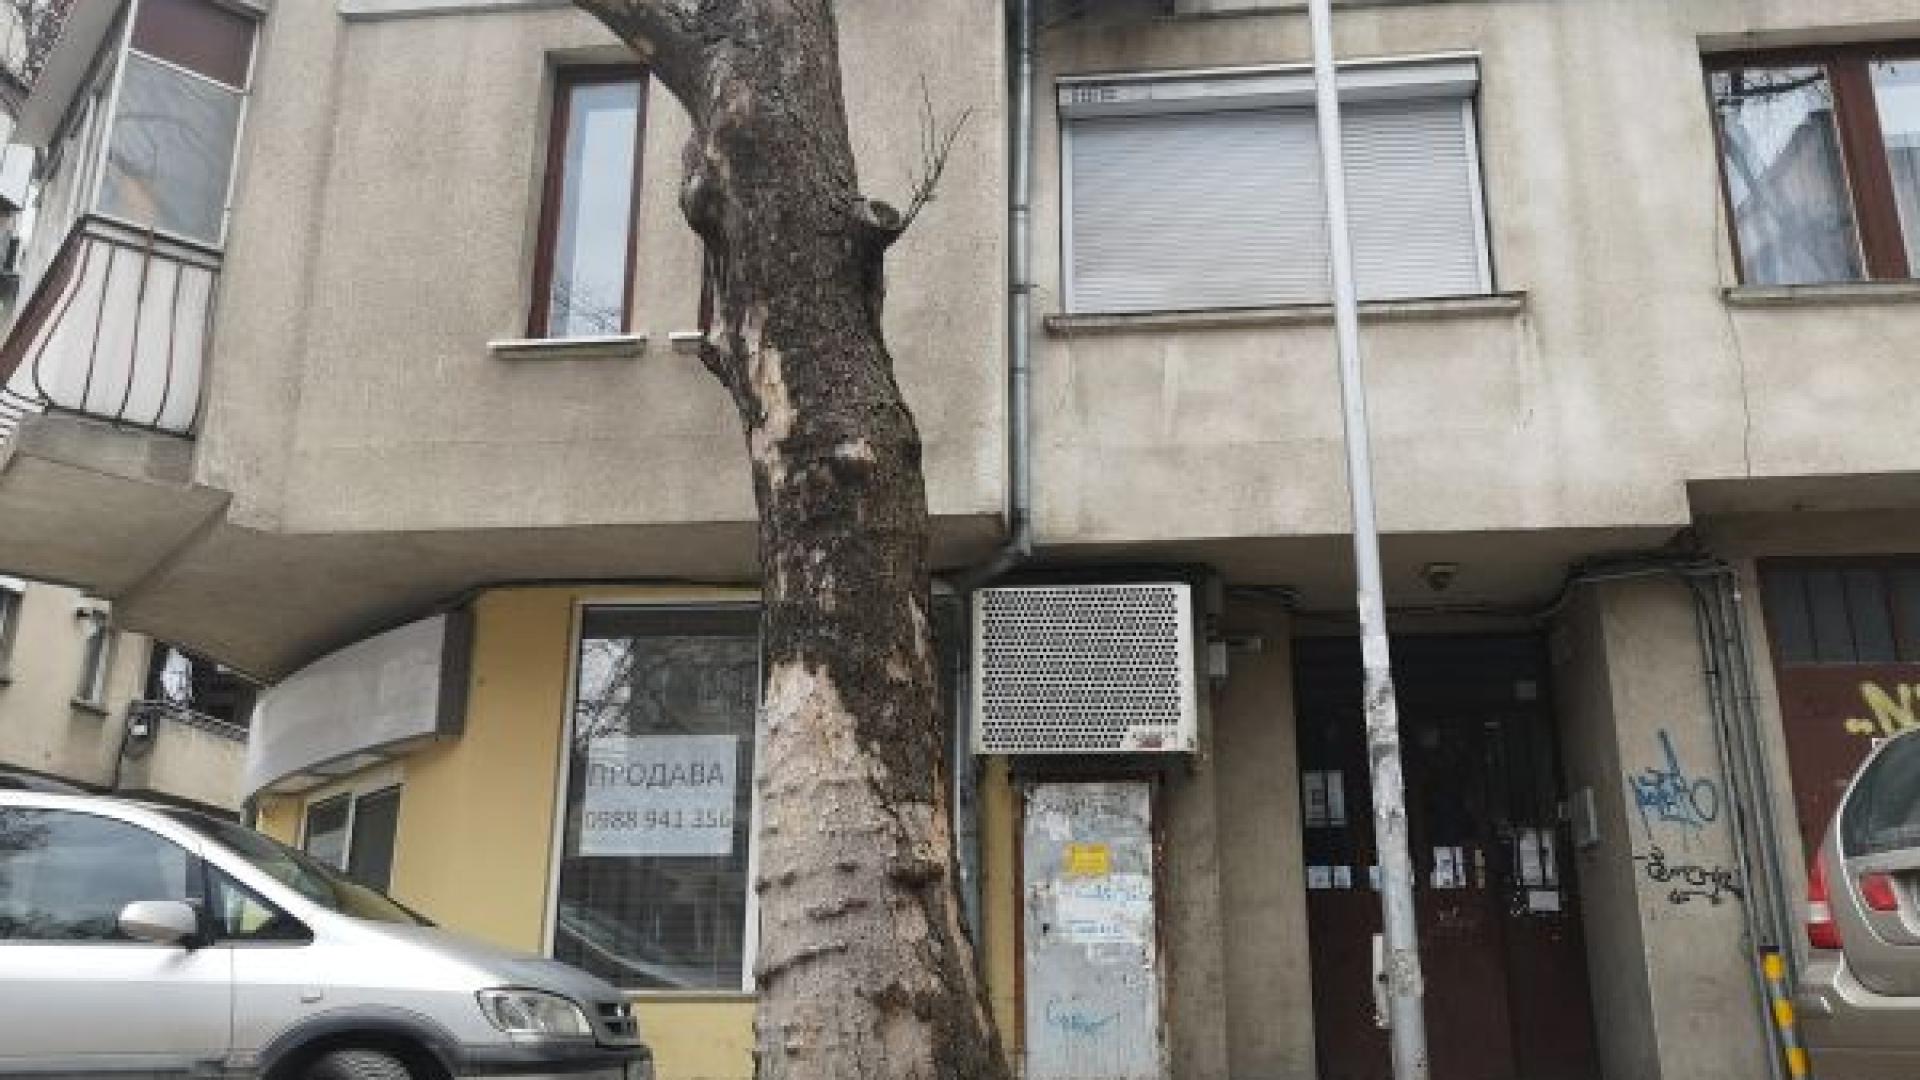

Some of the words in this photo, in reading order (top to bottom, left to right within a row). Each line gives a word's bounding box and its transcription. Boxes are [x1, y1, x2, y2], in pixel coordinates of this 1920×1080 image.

[587, 761, 725, 788] ПРОДАВА
[584, 809, 639, 831] 0988
[645, 808, 683, 830] 941
